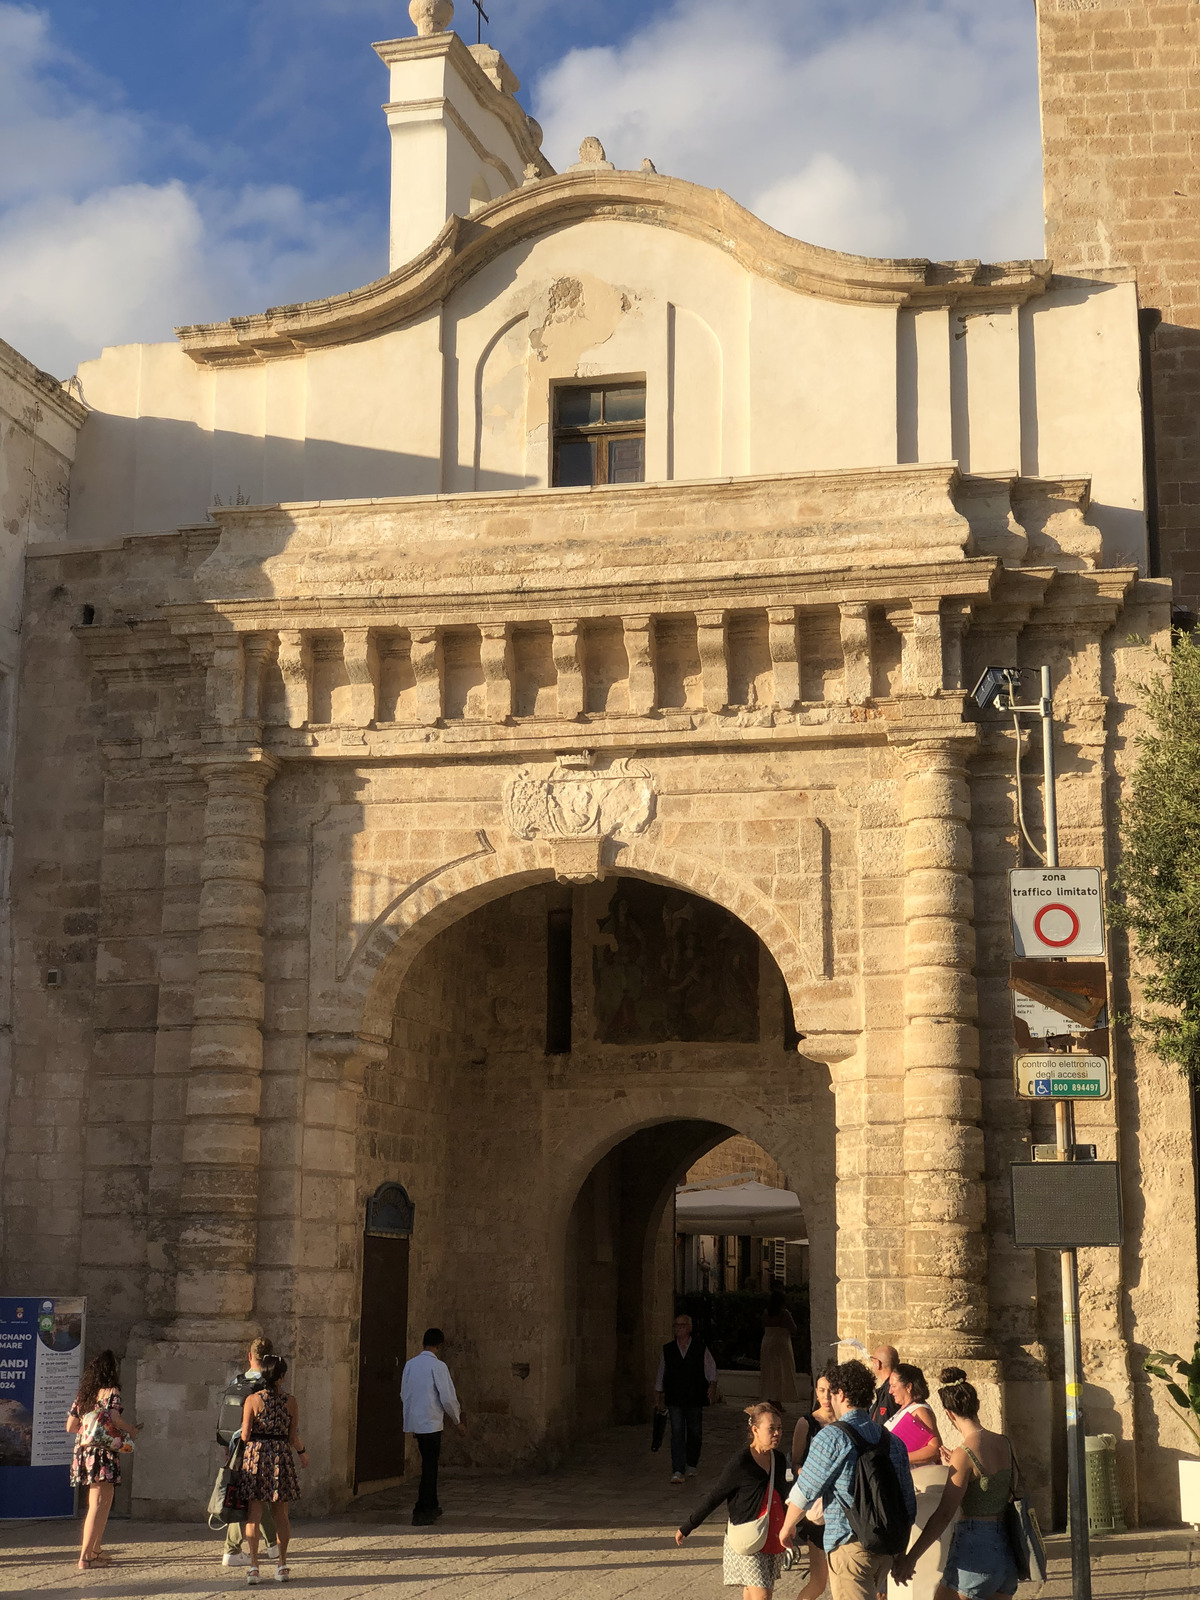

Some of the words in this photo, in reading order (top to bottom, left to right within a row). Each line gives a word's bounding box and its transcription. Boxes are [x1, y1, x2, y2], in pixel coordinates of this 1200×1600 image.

[1013, 888, 1052, 896] traffico
[1057, 887, 1098, 895] limitato
[1058, 1060, 1101, 1068] elettronico
[1036, 1070, 1055, 1080] degli
[1058, 1070, 1088, 1078] accessi
[1053, 1083, 1068, 1091] 800
[1072, 1083, 1098, 1091] 894497
[0, 1360, 28, 1368] ANDI
[1, 1371, 25, 1379] ENTI
